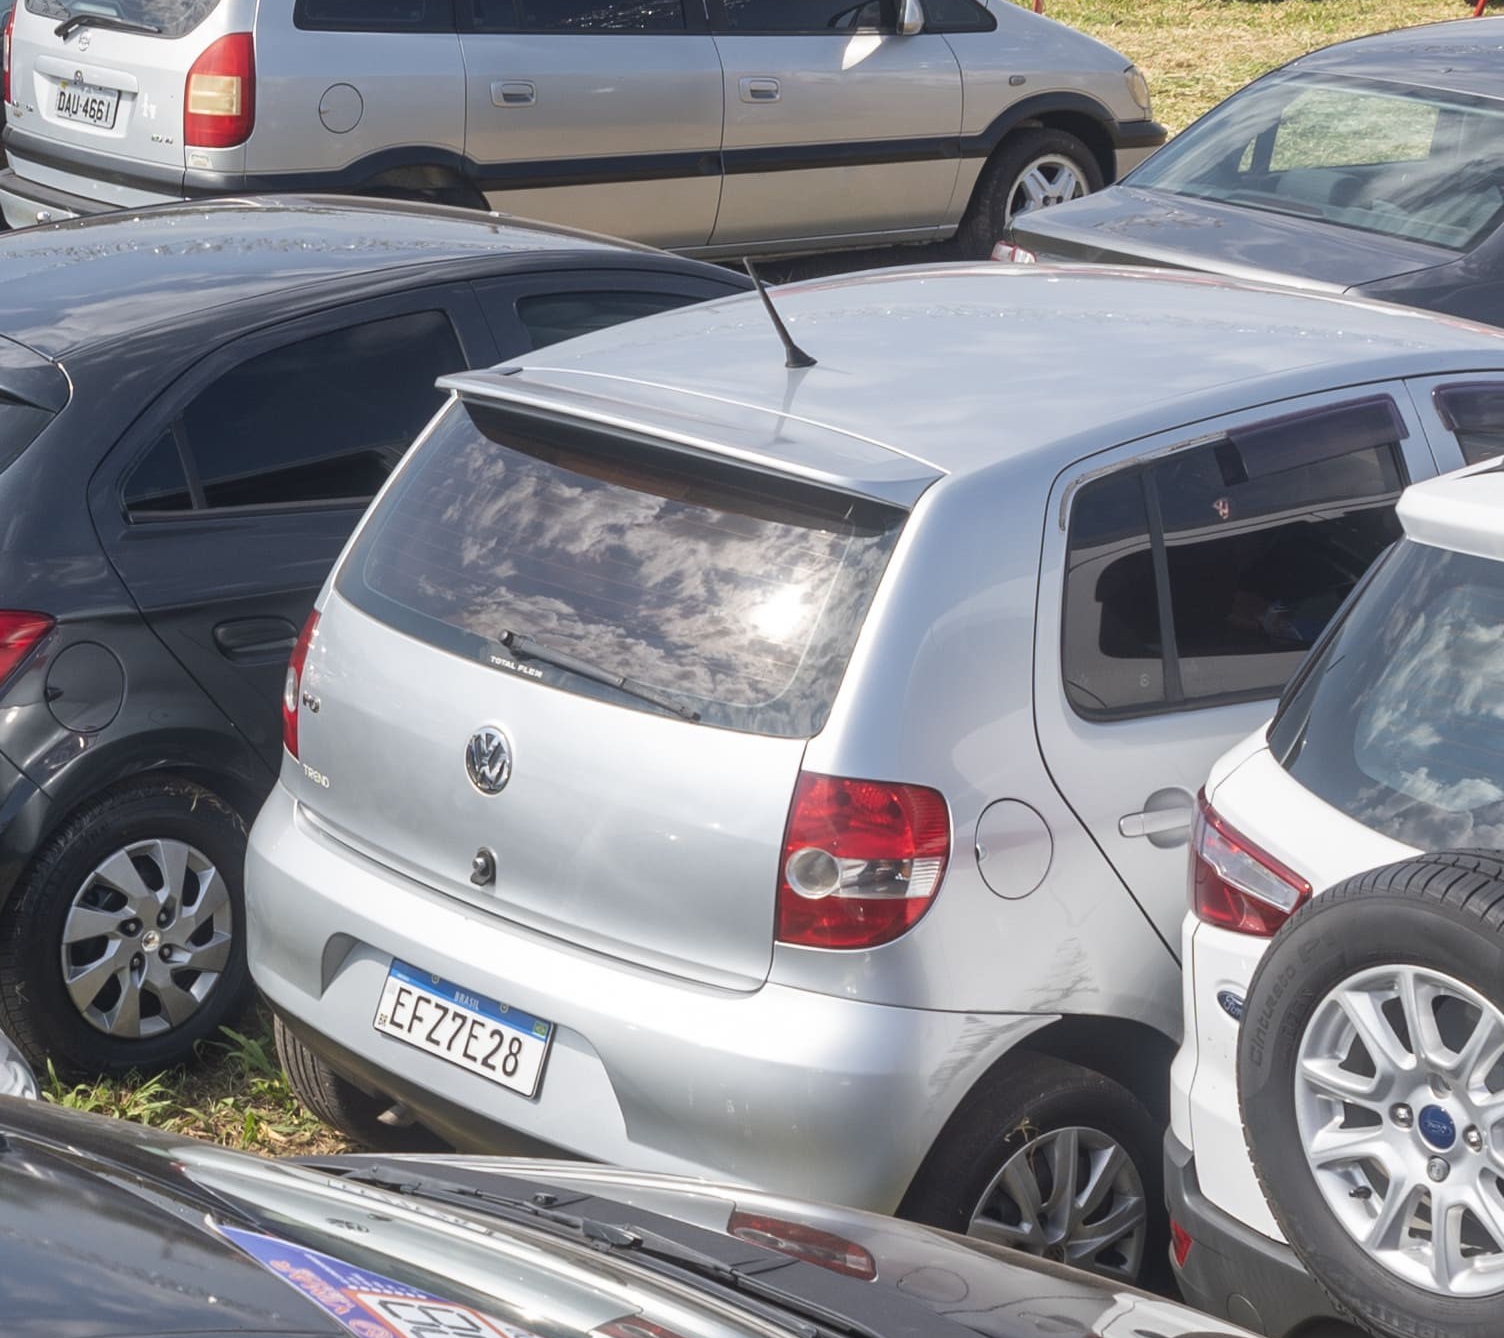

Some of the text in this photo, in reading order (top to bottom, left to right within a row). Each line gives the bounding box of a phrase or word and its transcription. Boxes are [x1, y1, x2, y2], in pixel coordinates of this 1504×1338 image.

[490, 655, 544, 679] TOTAL FLEX
[303, 763, 331, 790] TREND
[453, 991, 480, 1011] BRASIL
[388, 986, 523, 1078] EFZ7E28
